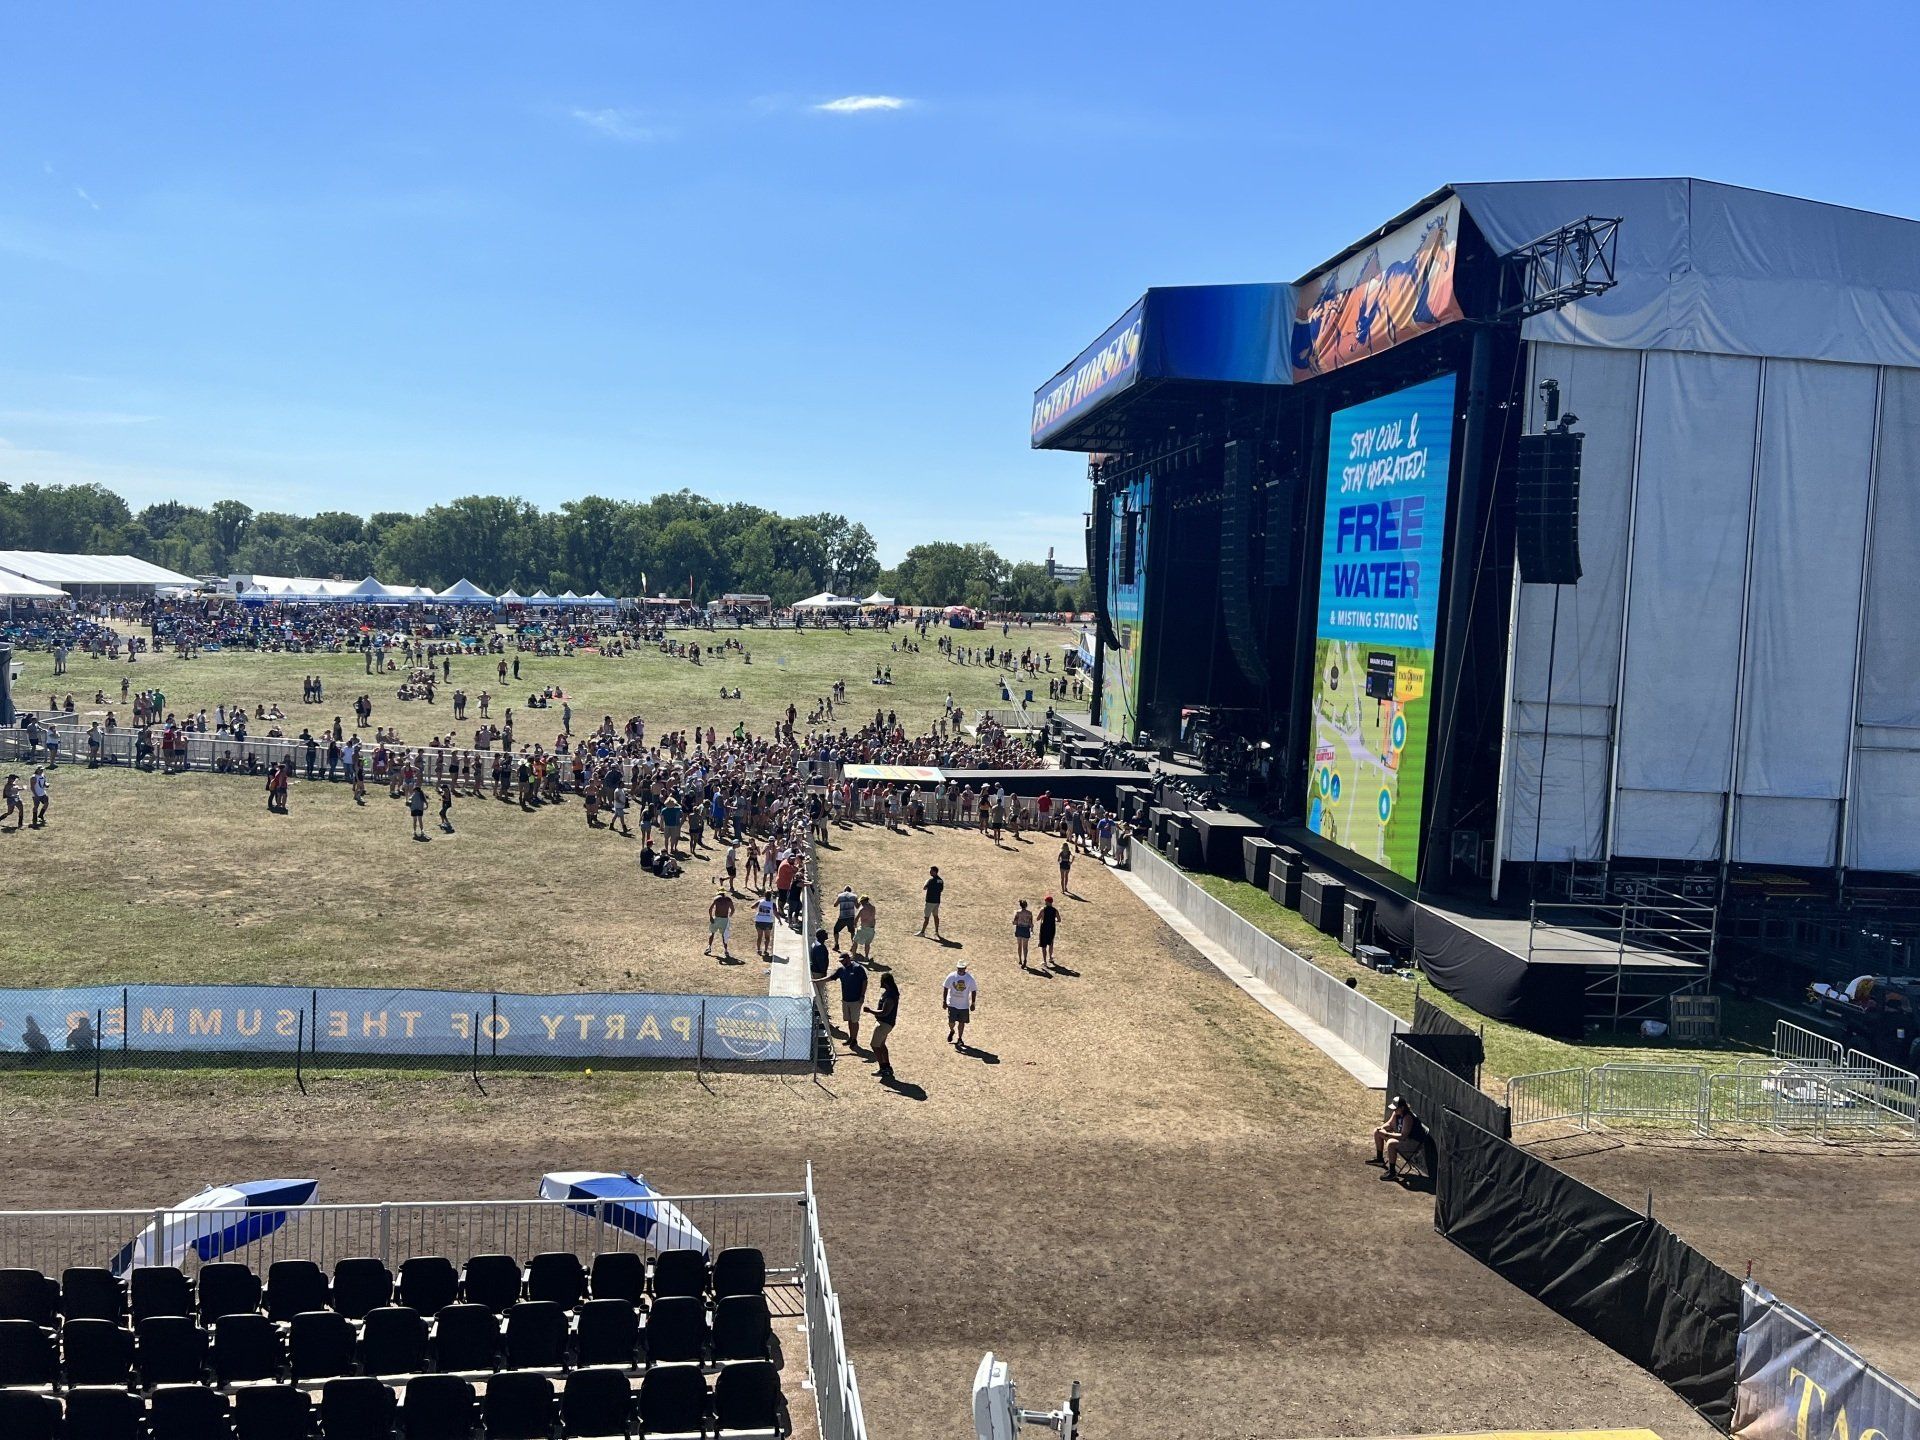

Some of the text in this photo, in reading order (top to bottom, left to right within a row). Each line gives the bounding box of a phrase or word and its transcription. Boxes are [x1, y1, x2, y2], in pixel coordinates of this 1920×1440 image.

[1349, 412, 1420, 460] STAY COOL &
[1340, 447, 1428, 494] STAY HYDRATED!
[1336, 495, 1426, 554] FREE
[1334, 560, 1422, 600] WATER
[1329, 609, 1419, 631] & MISTING STATIONS
[1369, 658, 1394, 667] MAIN STAGE
